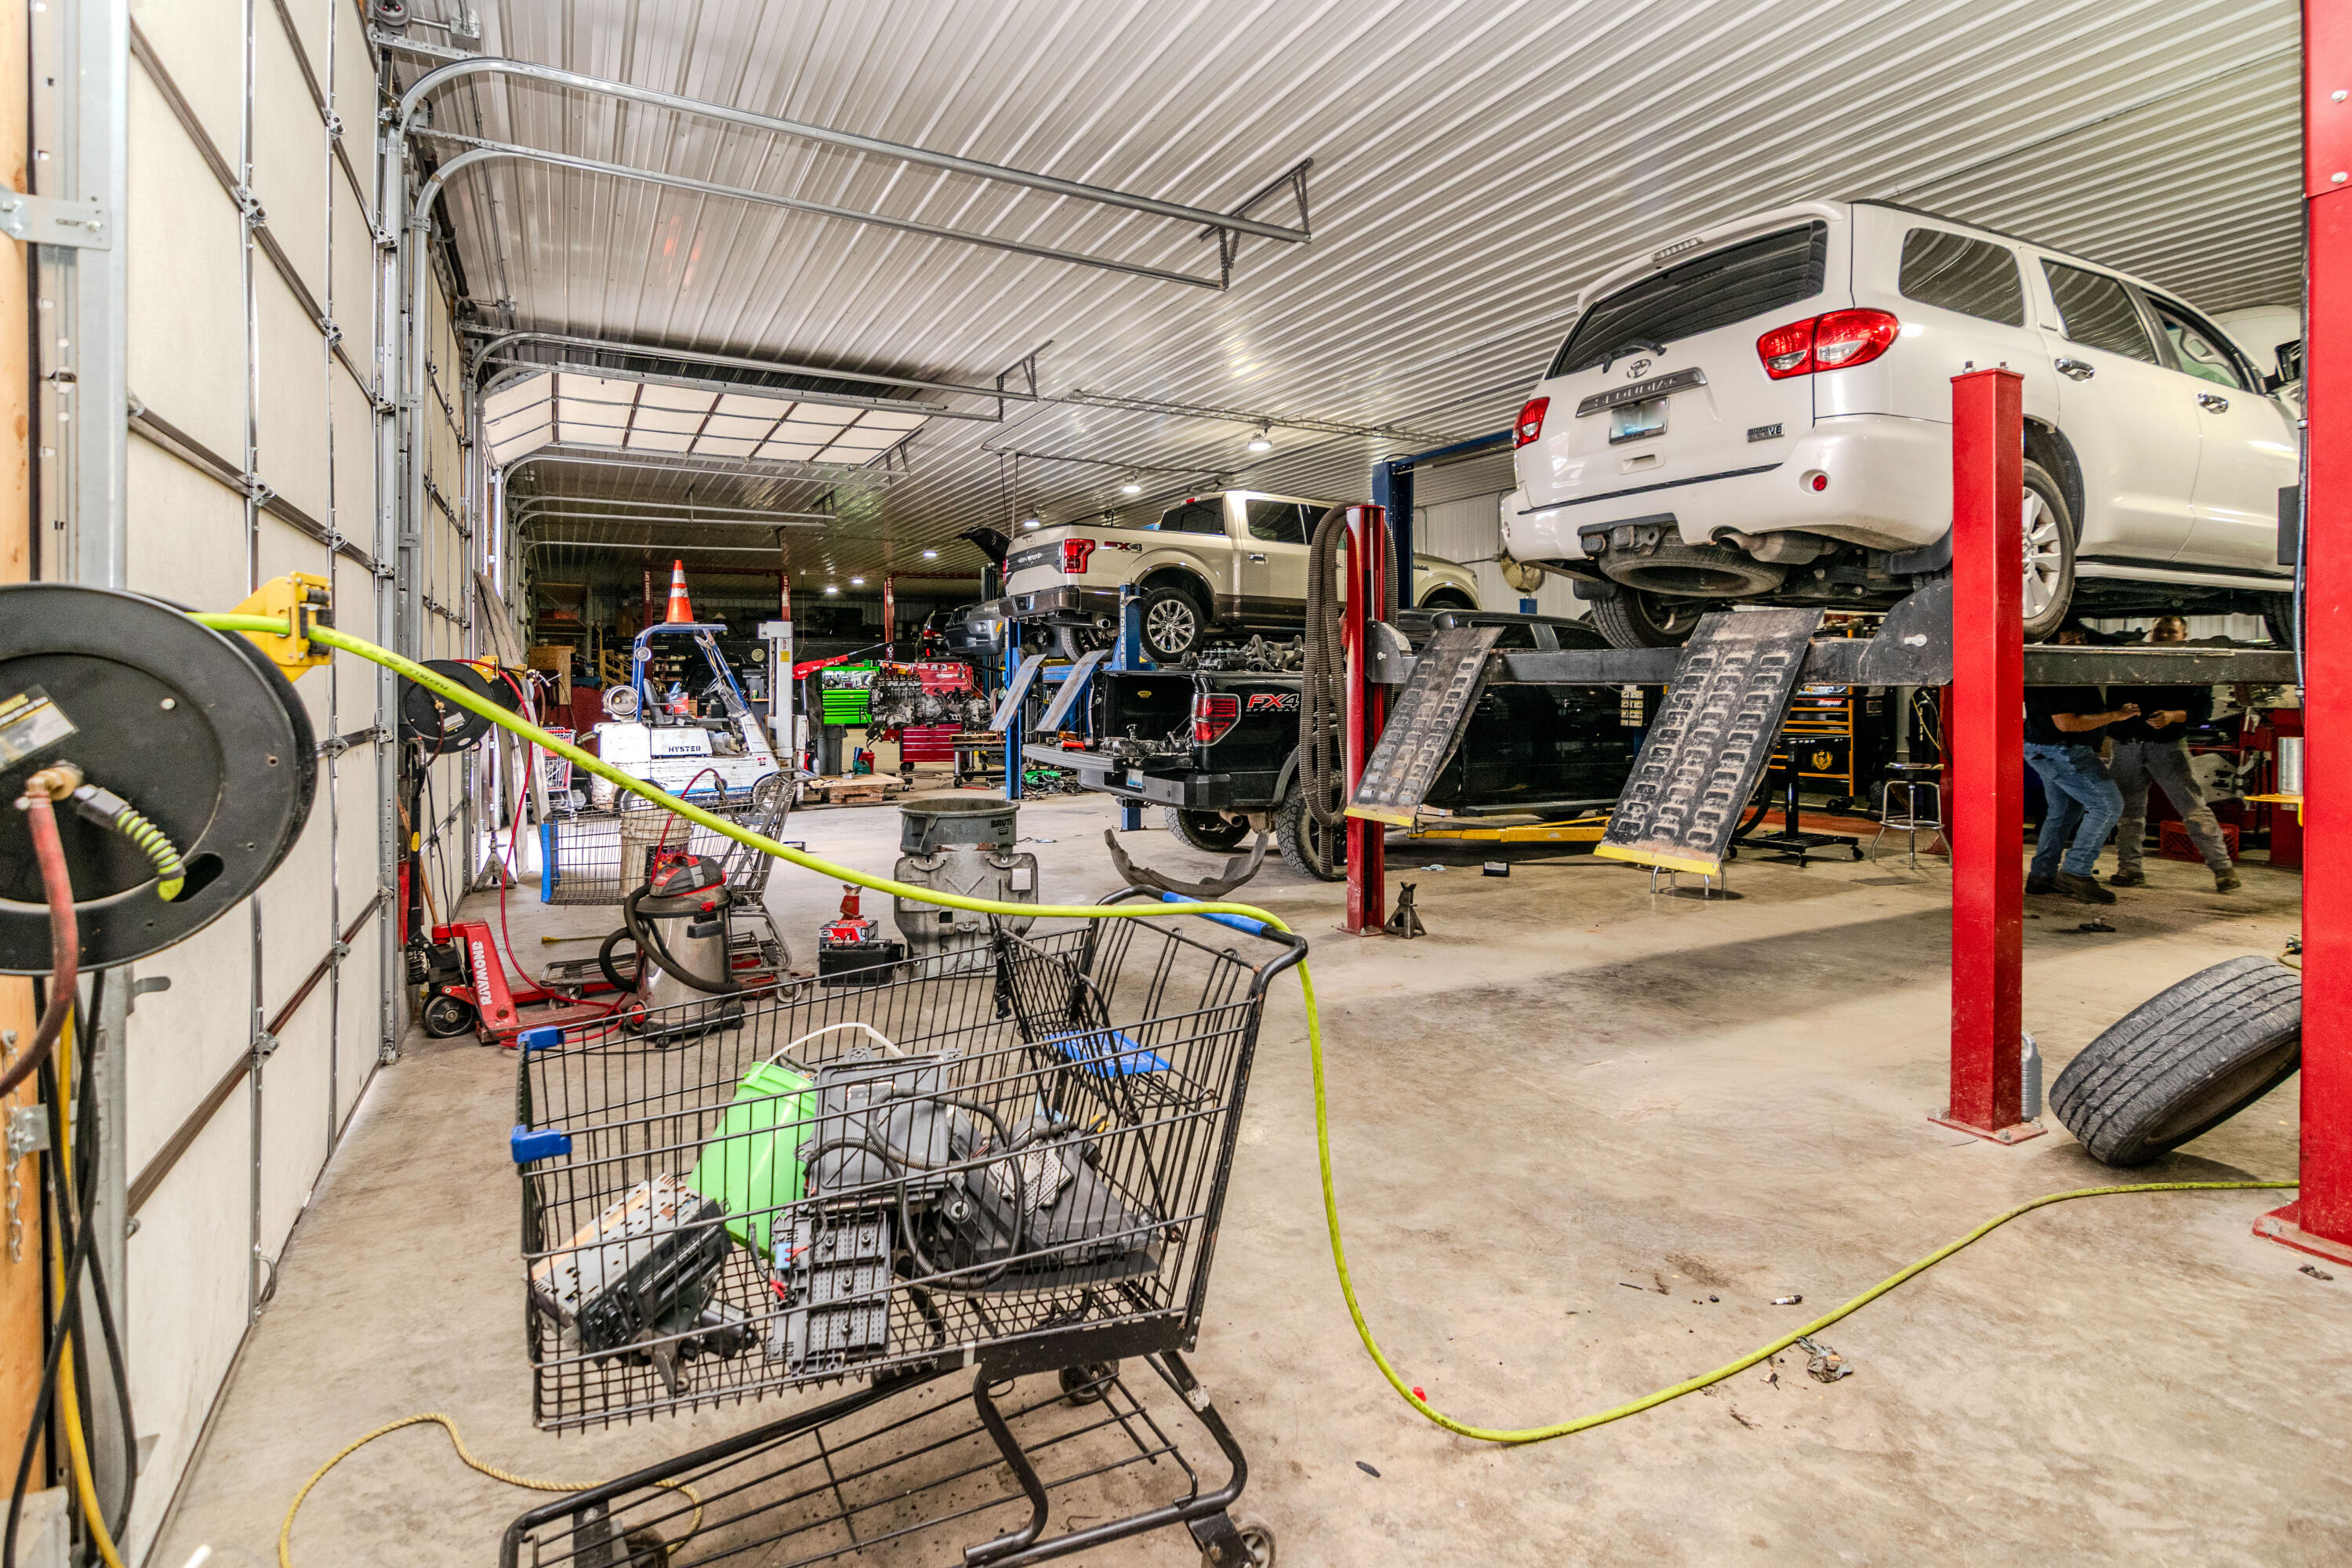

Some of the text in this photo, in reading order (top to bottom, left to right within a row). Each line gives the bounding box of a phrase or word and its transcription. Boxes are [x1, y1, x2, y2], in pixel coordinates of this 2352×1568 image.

[1247, 694, 1300, 708] FX4
[990, 817, 1013, 828] BRUTE
[471, 940, 493, 1006] RAYMOND
